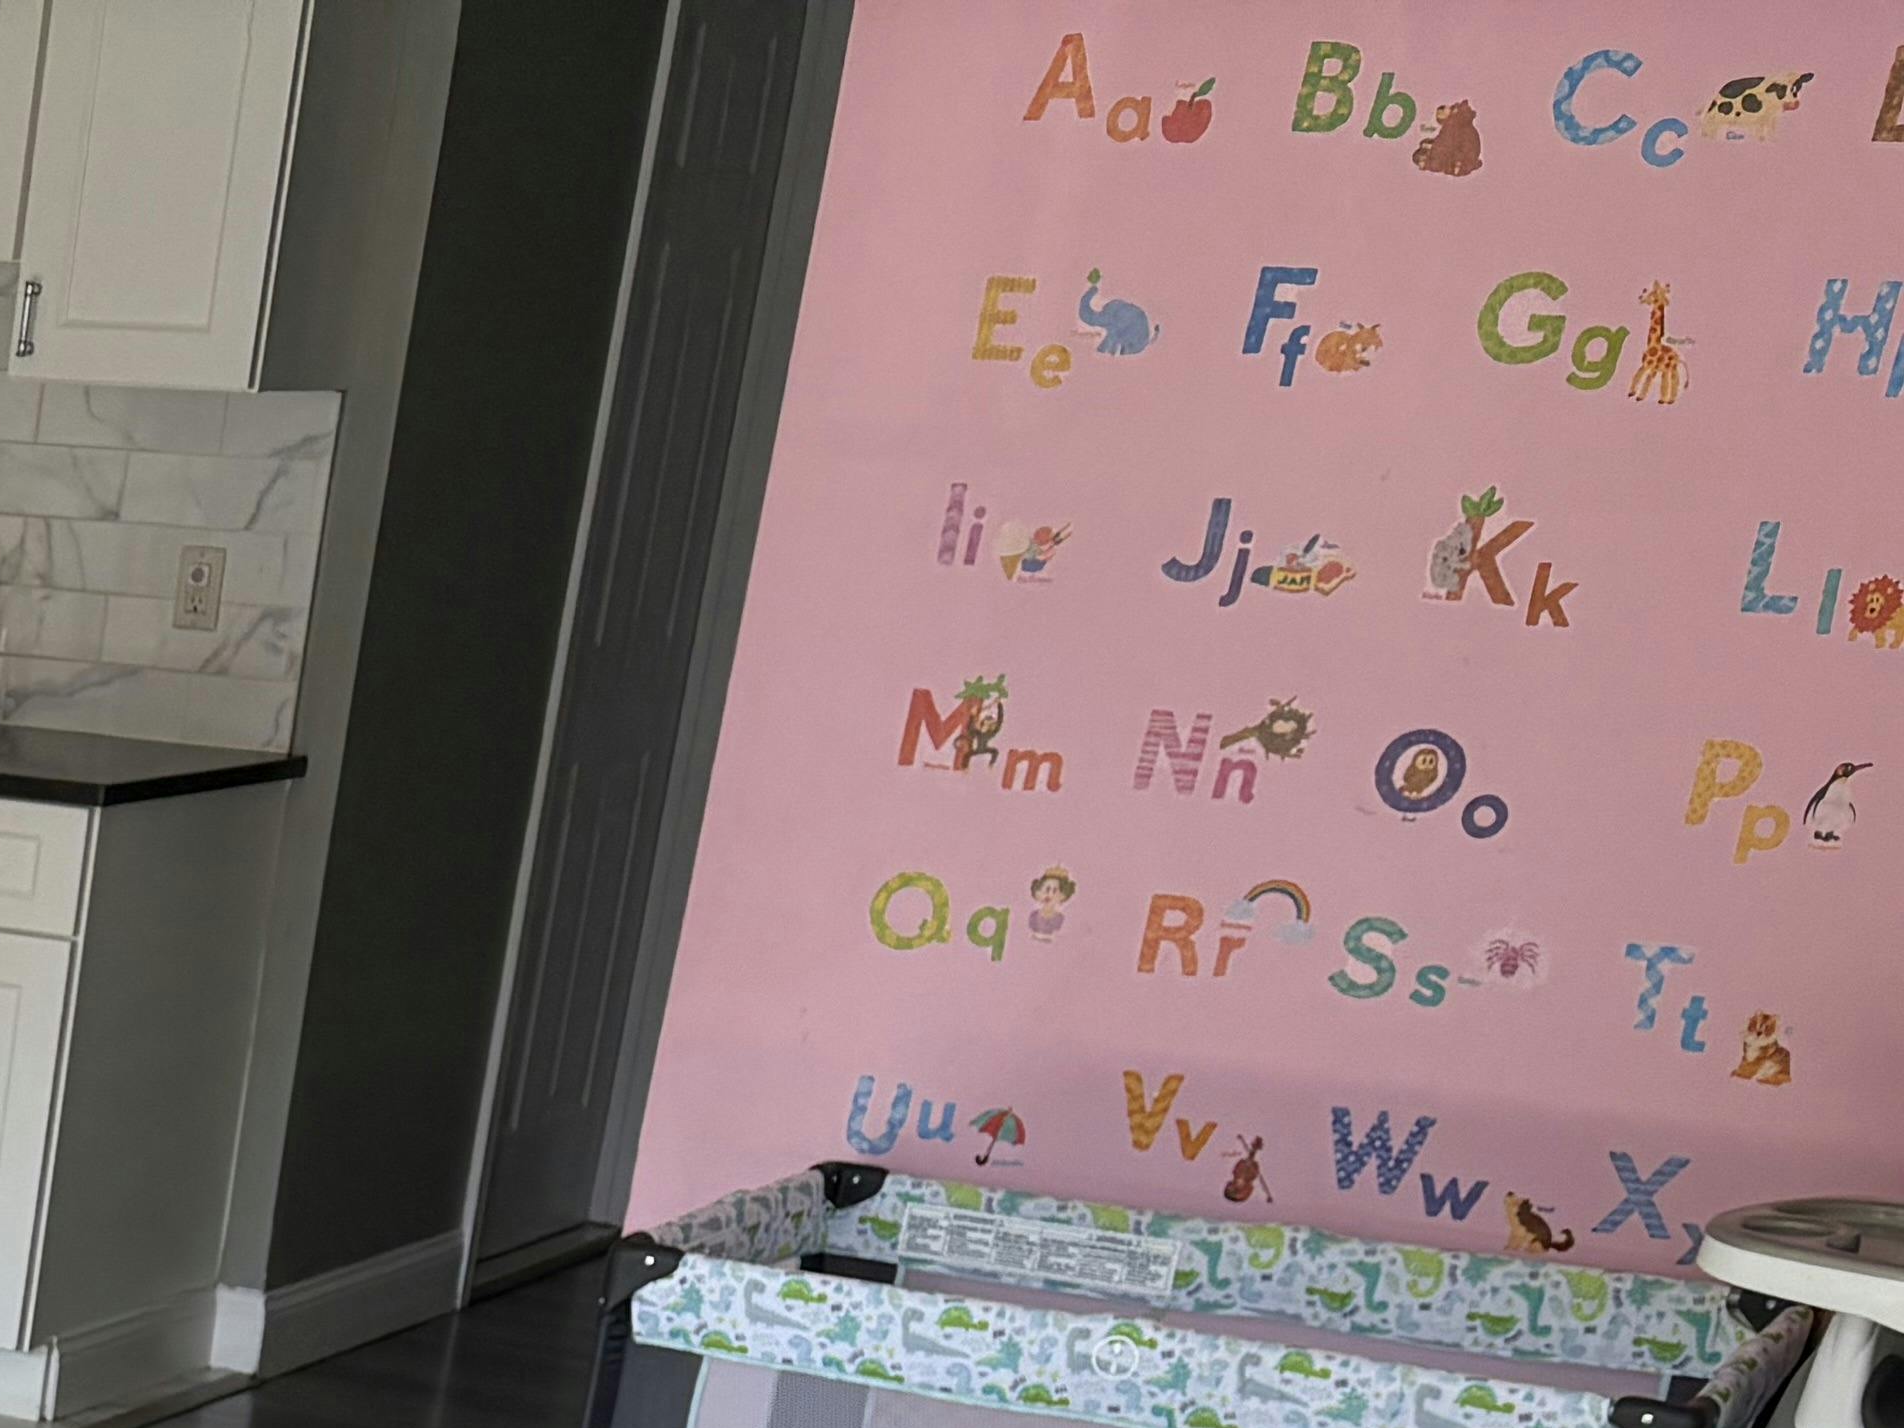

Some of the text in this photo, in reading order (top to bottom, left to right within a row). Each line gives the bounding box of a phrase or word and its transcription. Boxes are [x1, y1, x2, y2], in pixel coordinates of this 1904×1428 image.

[1023, 33, 1688, 167] Aa Bb Cc
[972, 276, 1071, 388] Ee
[1242, 266, 1318, 386] Ff
[1477, 271, 1630, 390] Gg
[1162, 498, 1252, 607] Jj
[1445, 515, 1579, 627] Kk
[897, 688, 1791, 864] Mm Nn Oo Pp
[870, 871, 1708, 1052] Qq Rr Ss Tt
[847, 1075, 956, 1155] Uu
[1123, 1070, 1218, 1161] Vv
[1332, 1107, 1489, 1220] Ww
